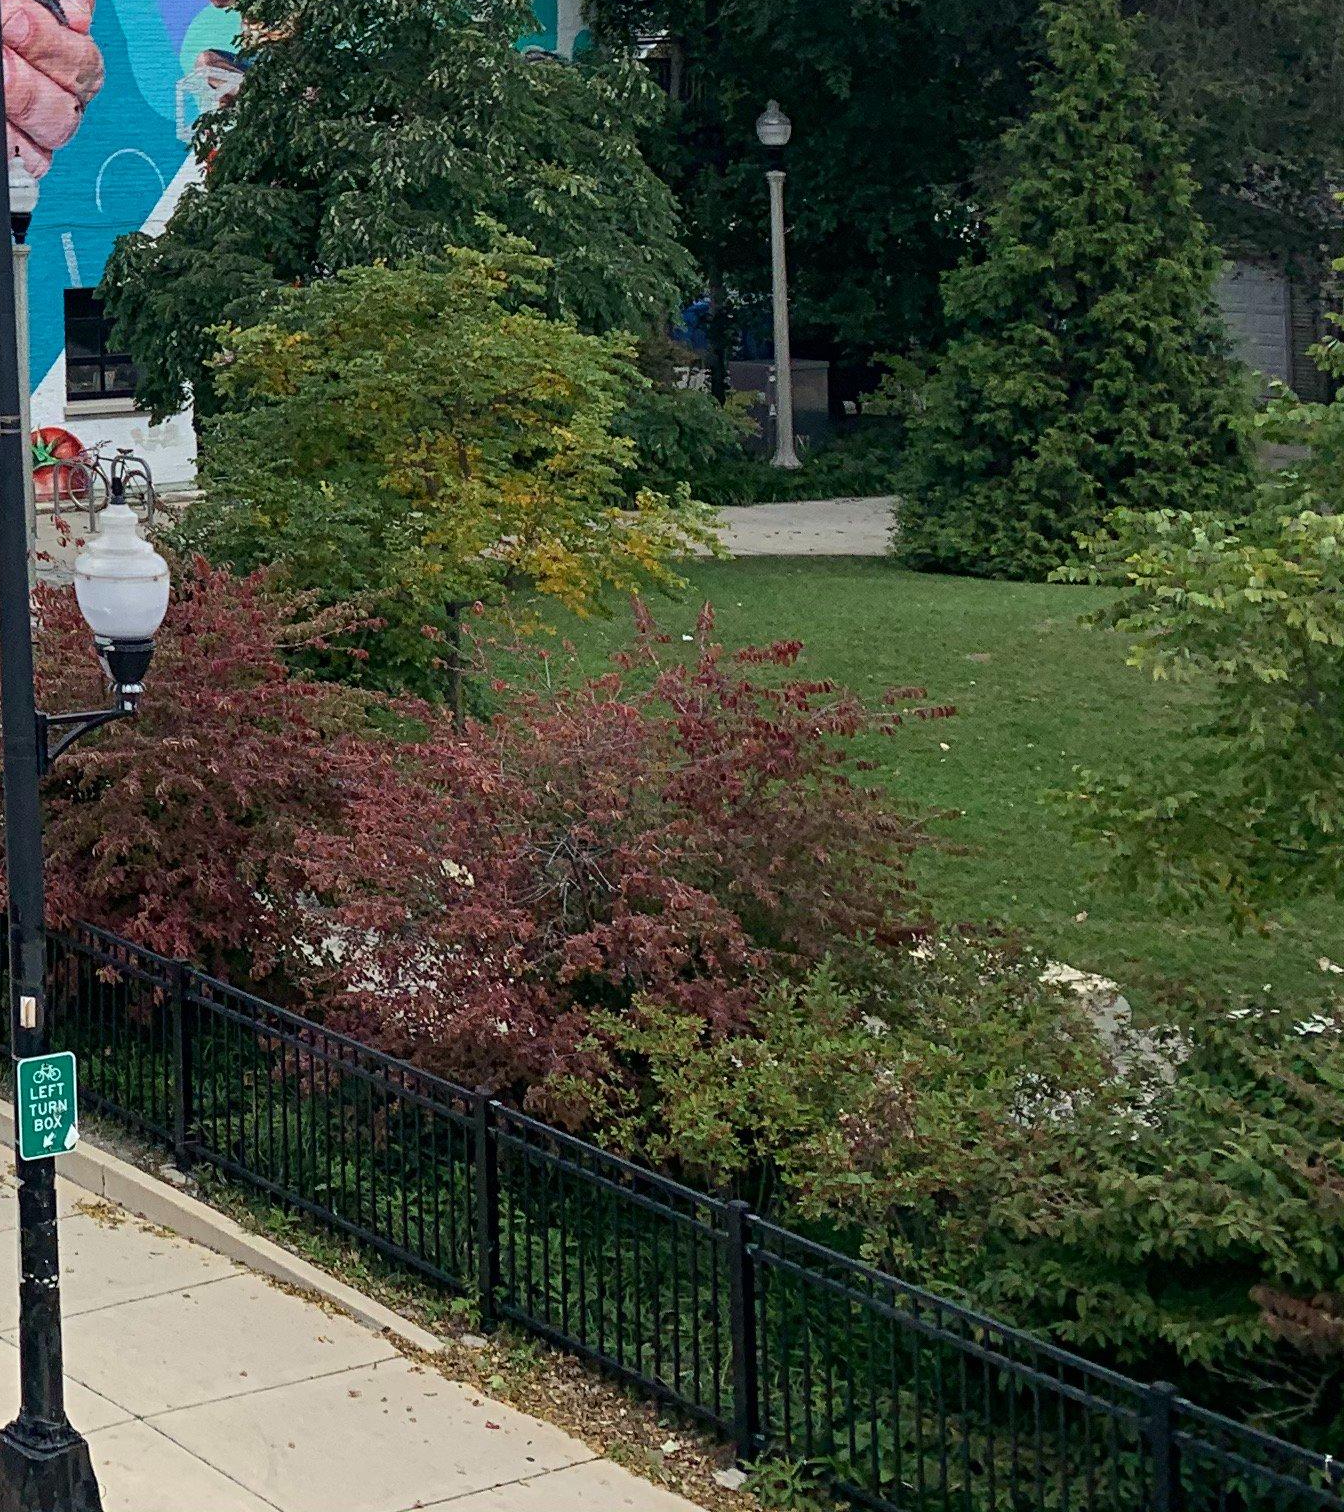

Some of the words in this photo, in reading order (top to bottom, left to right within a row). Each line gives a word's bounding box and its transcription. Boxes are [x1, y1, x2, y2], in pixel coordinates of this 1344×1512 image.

[29, 1082, 65, 1101] LEFT
[28, 1098, 68, 1117] TURN
[34, 1114, 63, 1132] BOX
